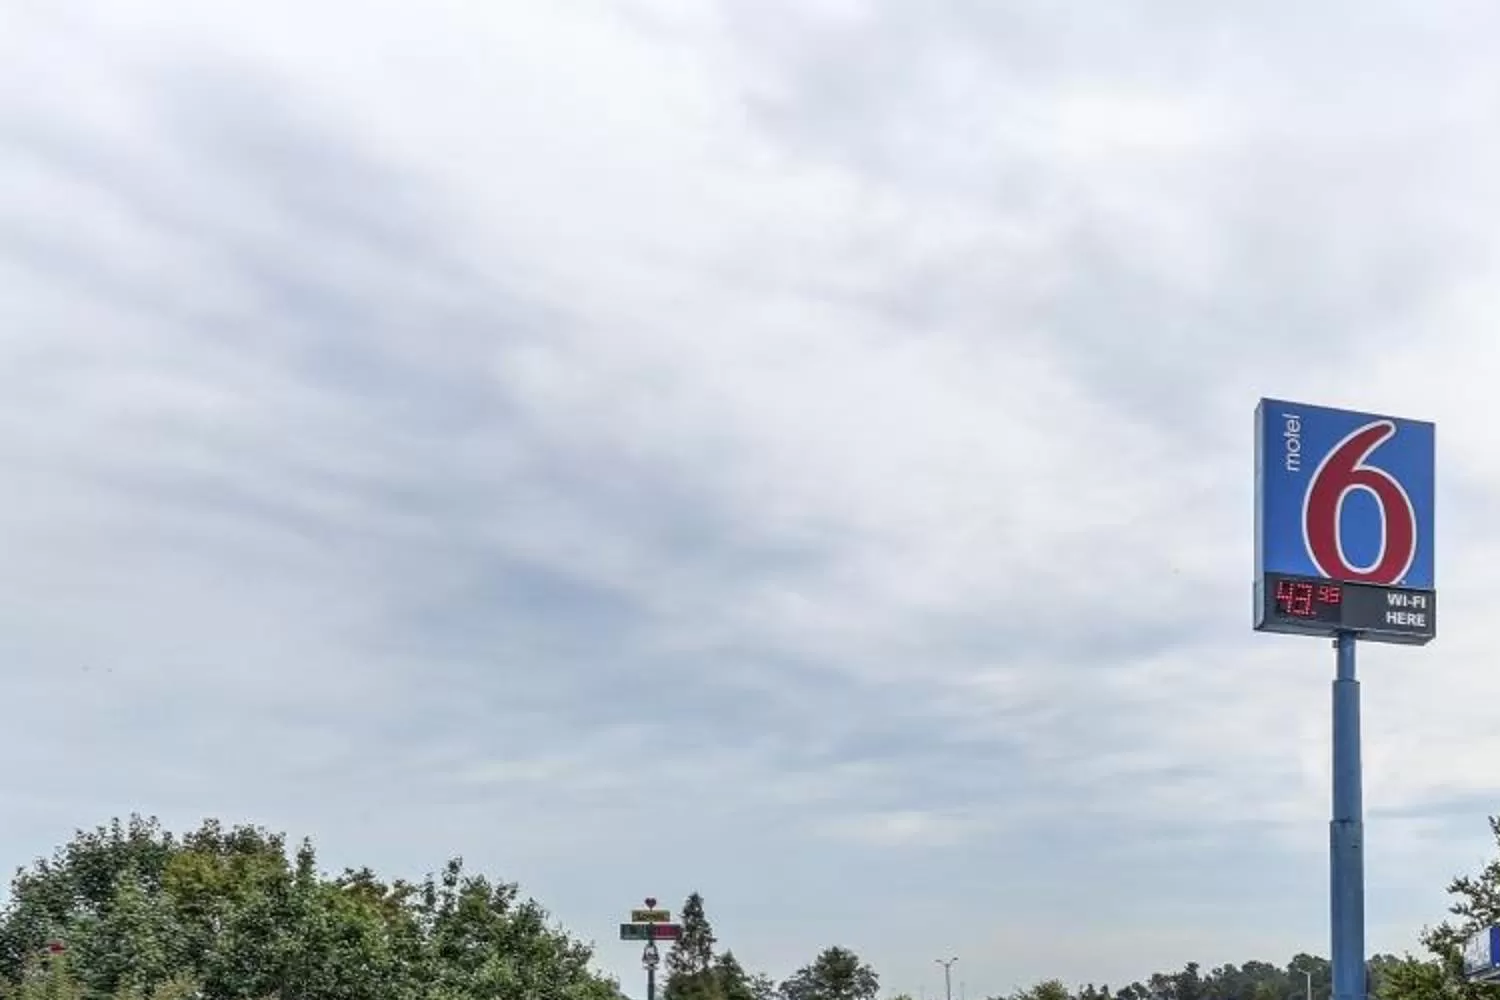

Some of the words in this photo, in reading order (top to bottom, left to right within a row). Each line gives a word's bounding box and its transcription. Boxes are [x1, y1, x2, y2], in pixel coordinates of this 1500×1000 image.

[1281, 413, 1301, 472] motel
[1302, 419, 1416, 586] 6
[1387, 591, 1426, 609] WI-FI
[1386, 611, 1426, 627] HERE
